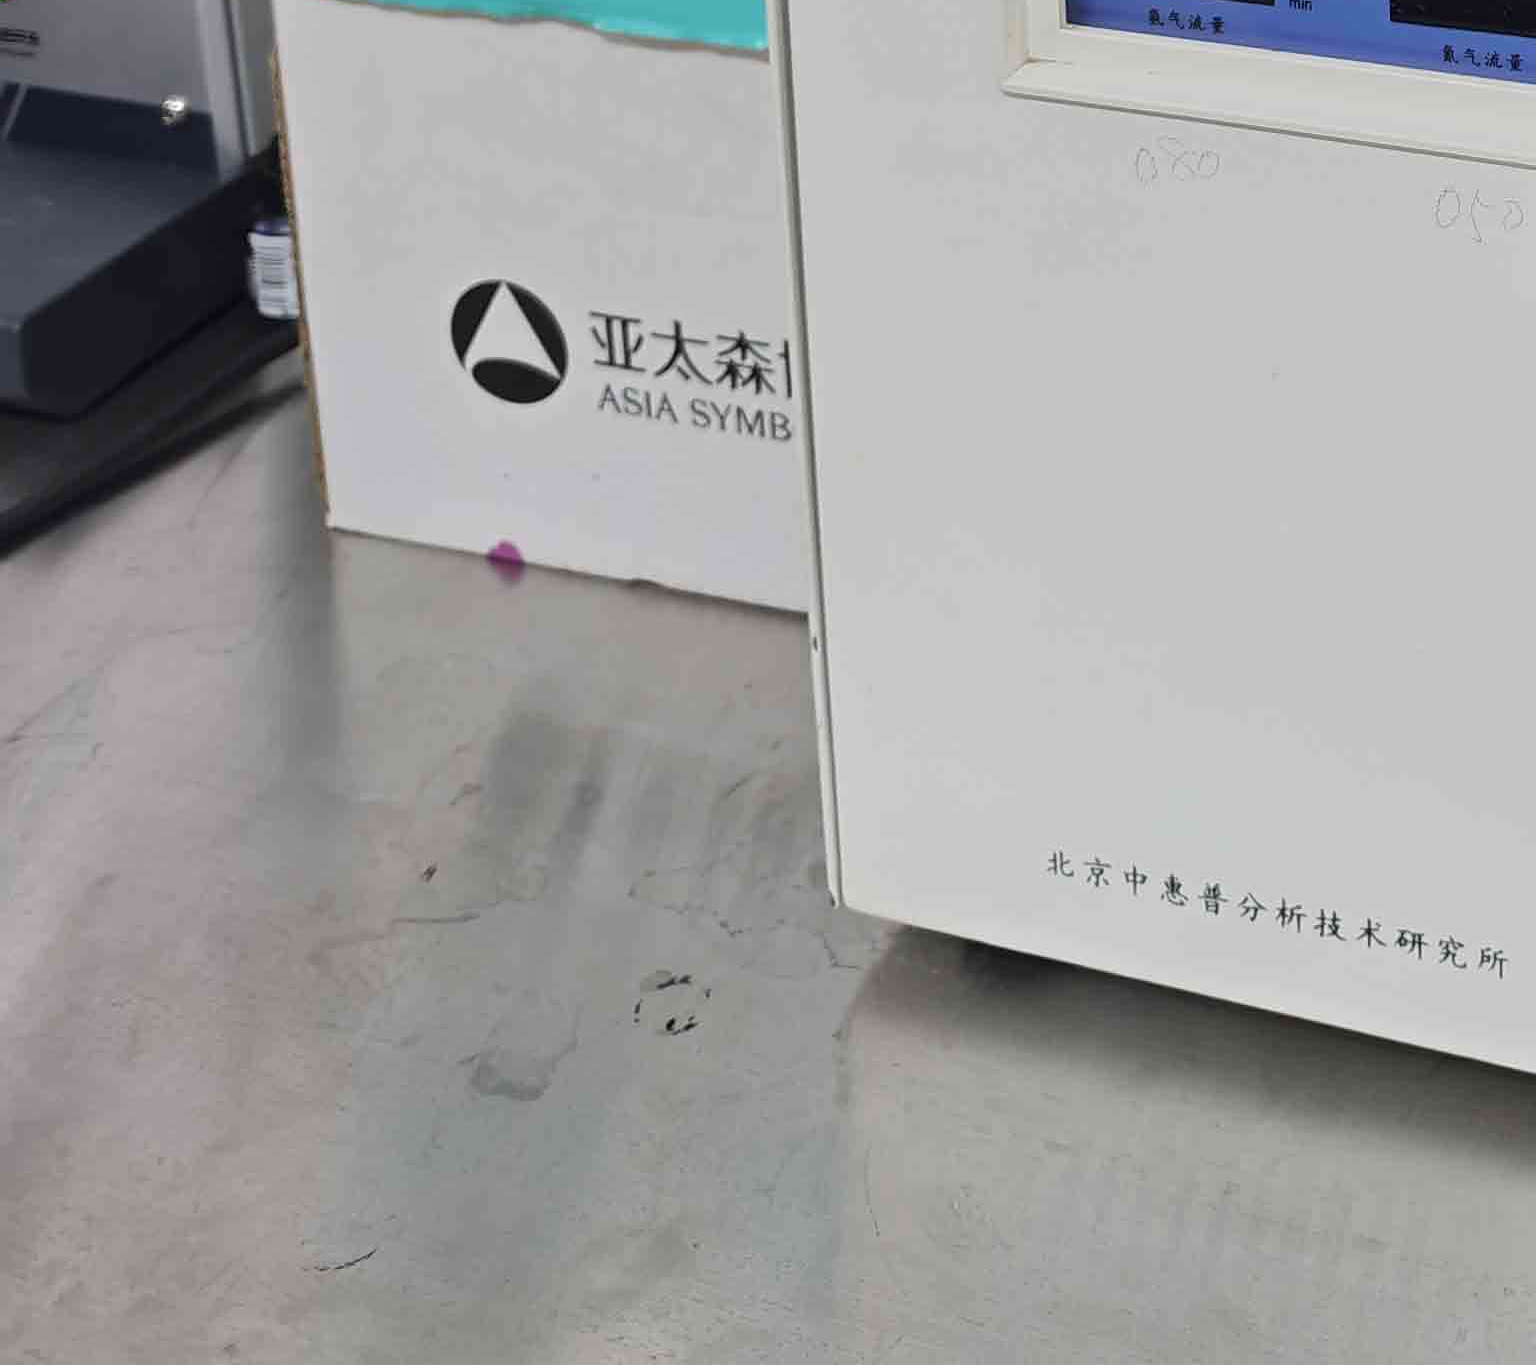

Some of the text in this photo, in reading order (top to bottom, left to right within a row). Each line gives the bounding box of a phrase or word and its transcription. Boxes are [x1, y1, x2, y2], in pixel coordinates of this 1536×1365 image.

[589, 310, 793, 400] 亚太森
[598, 382, 793, 443] ASIA SYMB
[1047, 850, 1508, 978] 北京中惠普分析技术研究所
